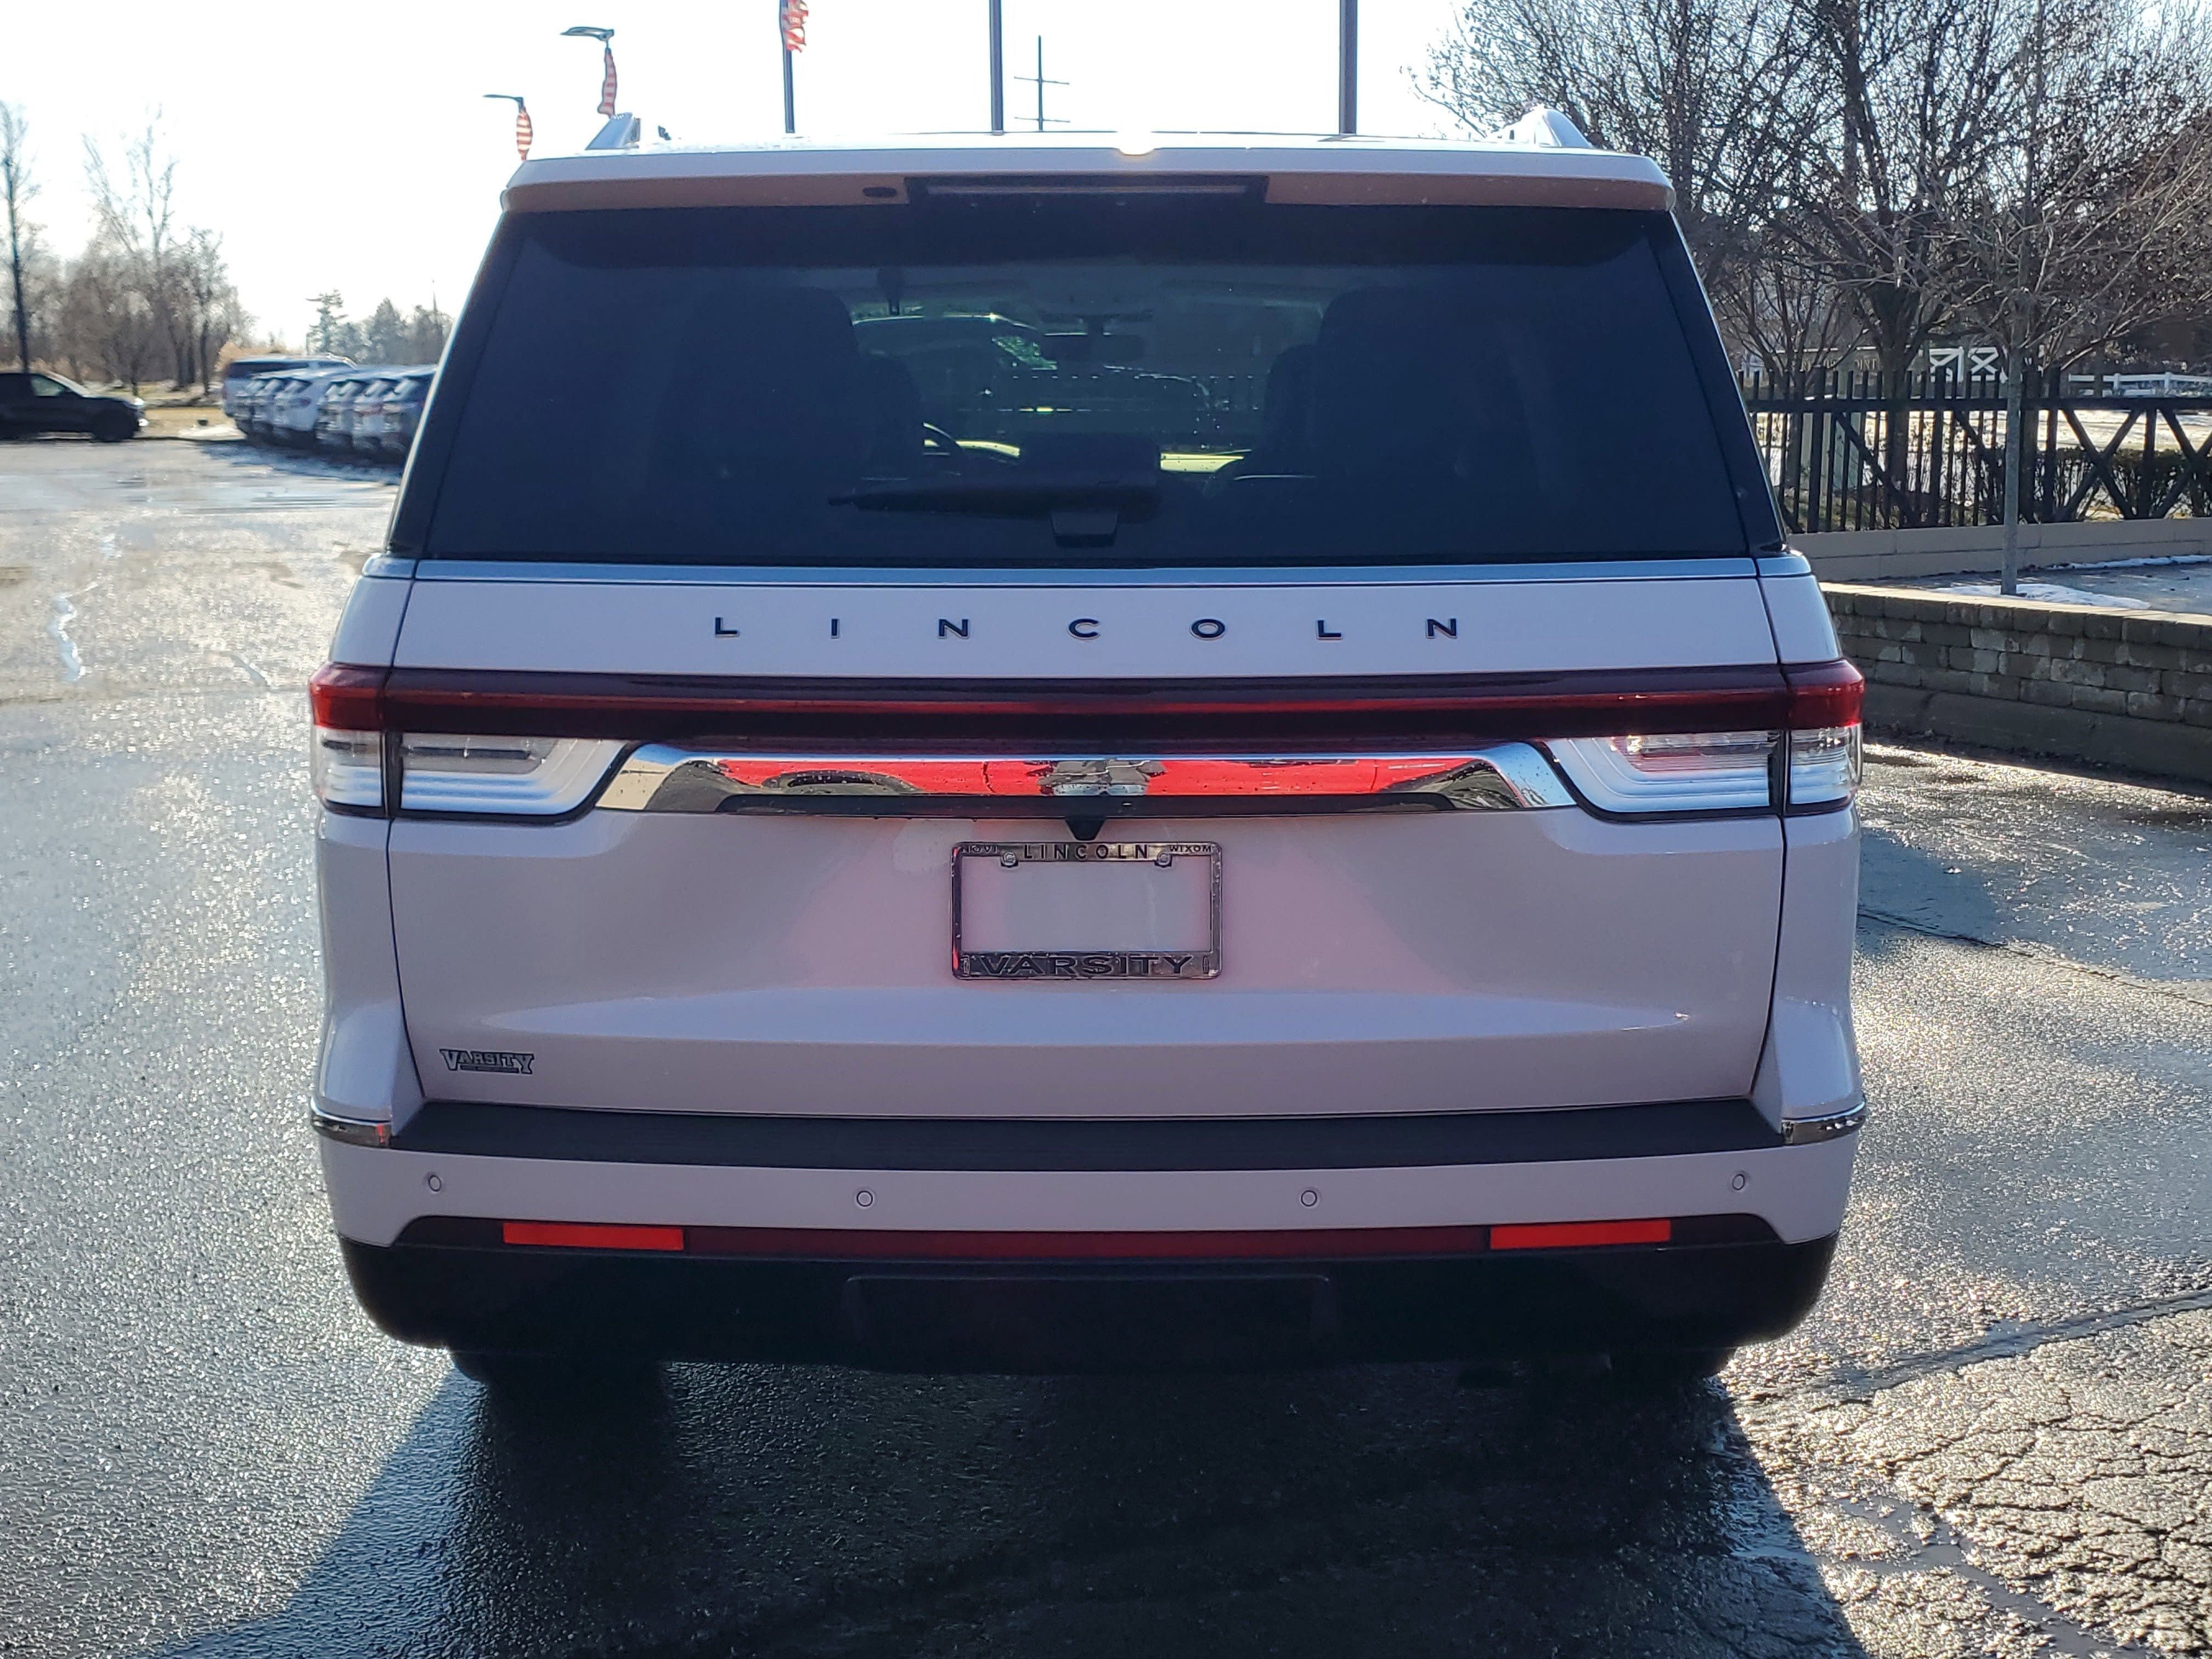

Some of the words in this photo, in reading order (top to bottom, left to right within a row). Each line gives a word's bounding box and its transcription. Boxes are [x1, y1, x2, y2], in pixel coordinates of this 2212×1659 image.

[714, 617, 1457, 640] LINCOLN
[961, 844, 998, 854] NOVI
[1024, 844, 1148, 860] LINCOLN
[1169, 844, 1211, 853] WIXOM
[979, 956, 1194, 975] VARSITY
[439, 1048, 535, 1075] VARSITY
